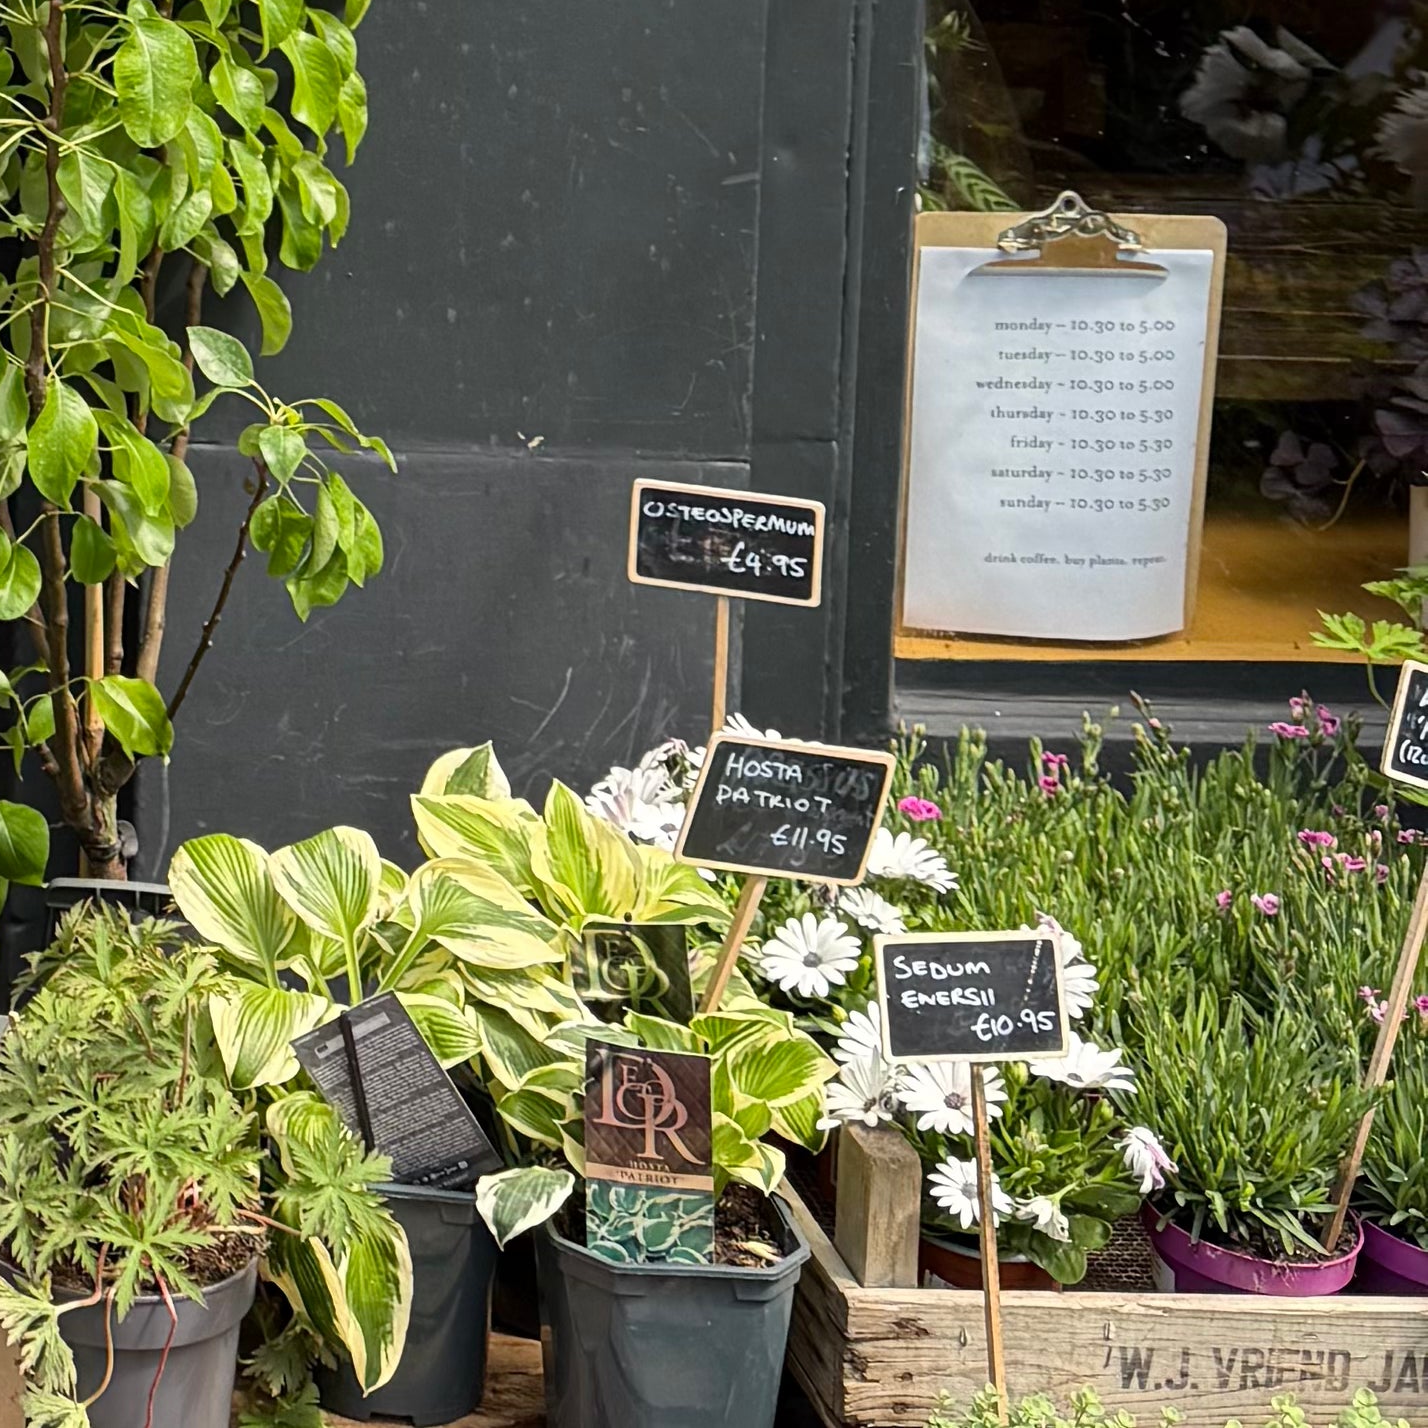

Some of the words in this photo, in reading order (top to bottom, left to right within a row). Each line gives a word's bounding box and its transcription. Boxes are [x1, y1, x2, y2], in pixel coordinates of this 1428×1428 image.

[995, 318, 1052, 335] monday
[1071, 320, 1115, 334] 10.30
[1120, 321, 1135, 331] to
[1139, 320, 1175, 334] 5.00
[999, 347, 1051, 364] tuesday
[1071, 349, 1115, 364] 10.30
[1120, 351, 1135, 361] to
[1139, 350, 1175, 364] 5.00
[976, 377, 1052, 394] wednesday
[1070, 379, 1114, 393] 10.30
[1119, 381, 1134, 391] to
[1139, 380, 1174, 394] 5.00
[991, 406, 1053, 423] thursday
[1072, 409, 1116, 423] 10.30
[1121, 411, 1135, 420] to
[1139, 409, 1173, 423] 5.30
[1011, 435, 1053, 453] friday
[1071, 439, 1116, 453] 10.30
[1120, 440, 1135, 450] to
[1139, 439, 1173, 453] 5.30
[991, 465, 1052, 483] saturday
[1070, 469, 1115, 483] 10.30
[1120, 470, 1134, 480] to
[1139, 468, 1172, 482] 5.30
[1000, 495, 1052, 512] sunday
[1070, 498, 1114, 512] 10.30
[1119, 499, 1134, 509] to
[1139, 497, 1170, 512] 5.30
[643, 501, 815, 536] OSTEOSPERMUM
[720, 541, 807, 577] £4.95
[725, 752, 803, 783] HOSTA
[715, 784, 832, 814] PATRIOT
[770, 824, 847, 855] £11.95
[893, 955, 991, 980] SEDUM
[970, 1008, 1056, 1041] £10.95
[1367, 1349, 1428, 1394] JA
